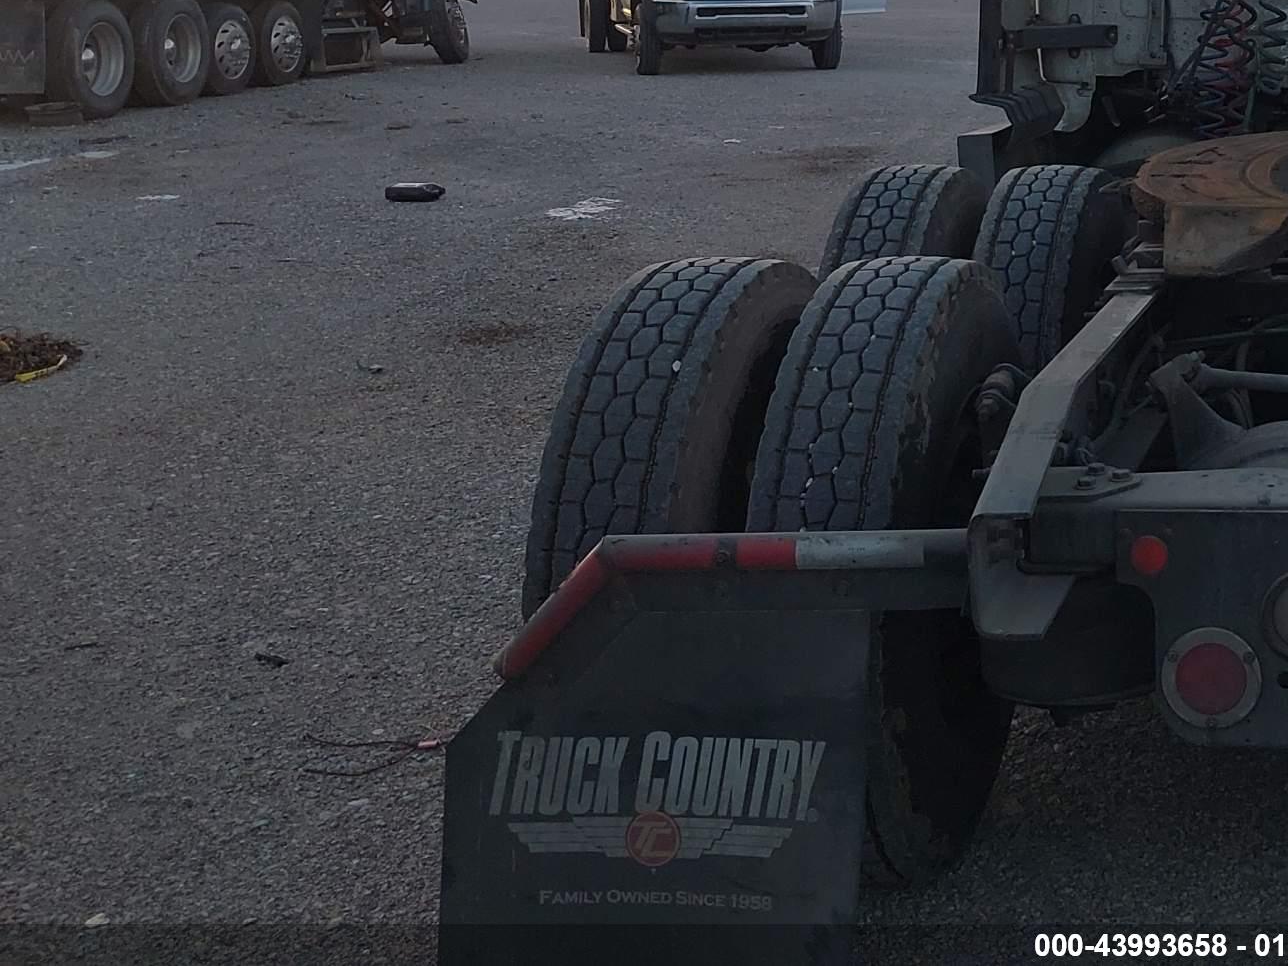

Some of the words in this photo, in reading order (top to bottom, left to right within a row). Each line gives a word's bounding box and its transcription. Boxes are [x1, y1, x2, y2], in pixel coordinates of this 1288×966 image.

[488, 731, 630, 817] TRUCK
[538, 889, 603, 906] FAMILY
[606, 889, 673, 907] OWNED
[675, 890, 726, 908] SINCE
[730, 892, 773, 912] 1958
